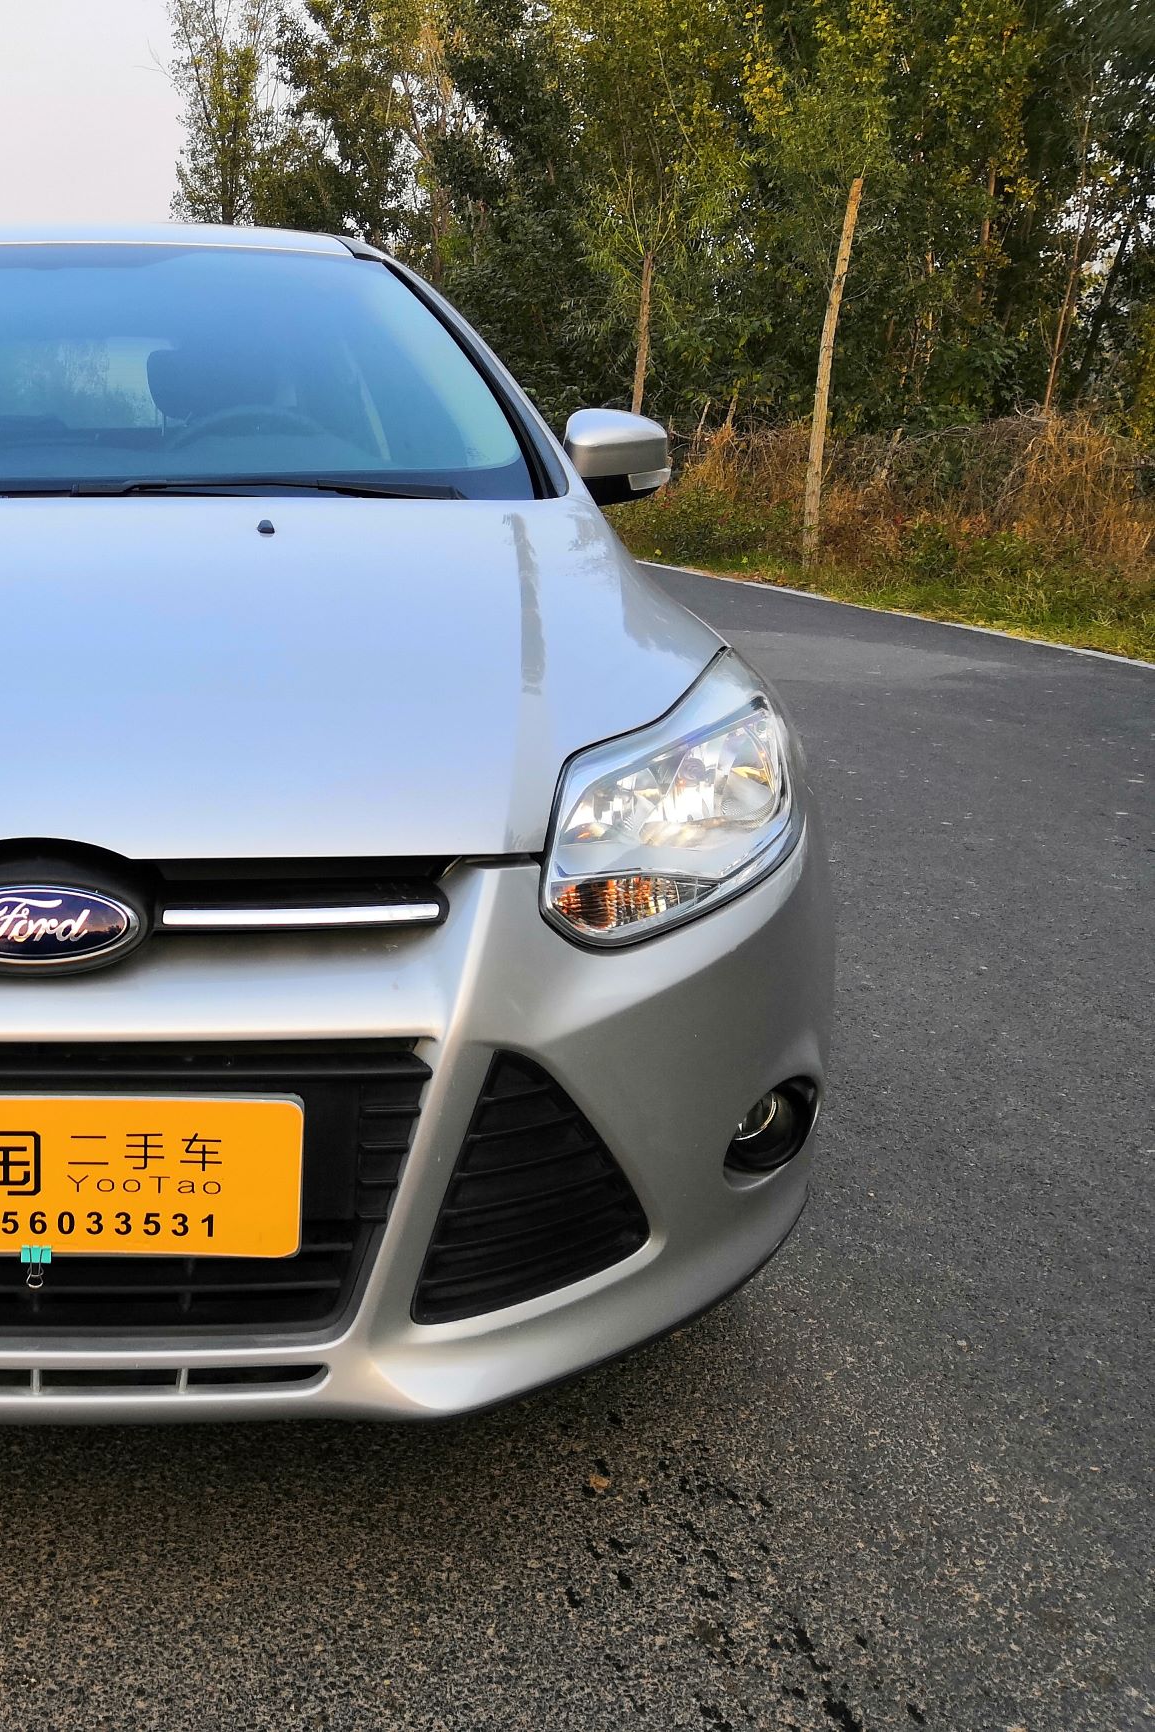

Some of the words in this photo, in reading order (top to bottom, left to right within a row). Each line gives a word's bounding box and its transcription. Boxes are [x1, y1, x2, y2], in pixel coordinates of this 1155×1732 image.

[67, 1132, 223, 1172] 二手车
[67, 1174, 223, 1195] YooTao
